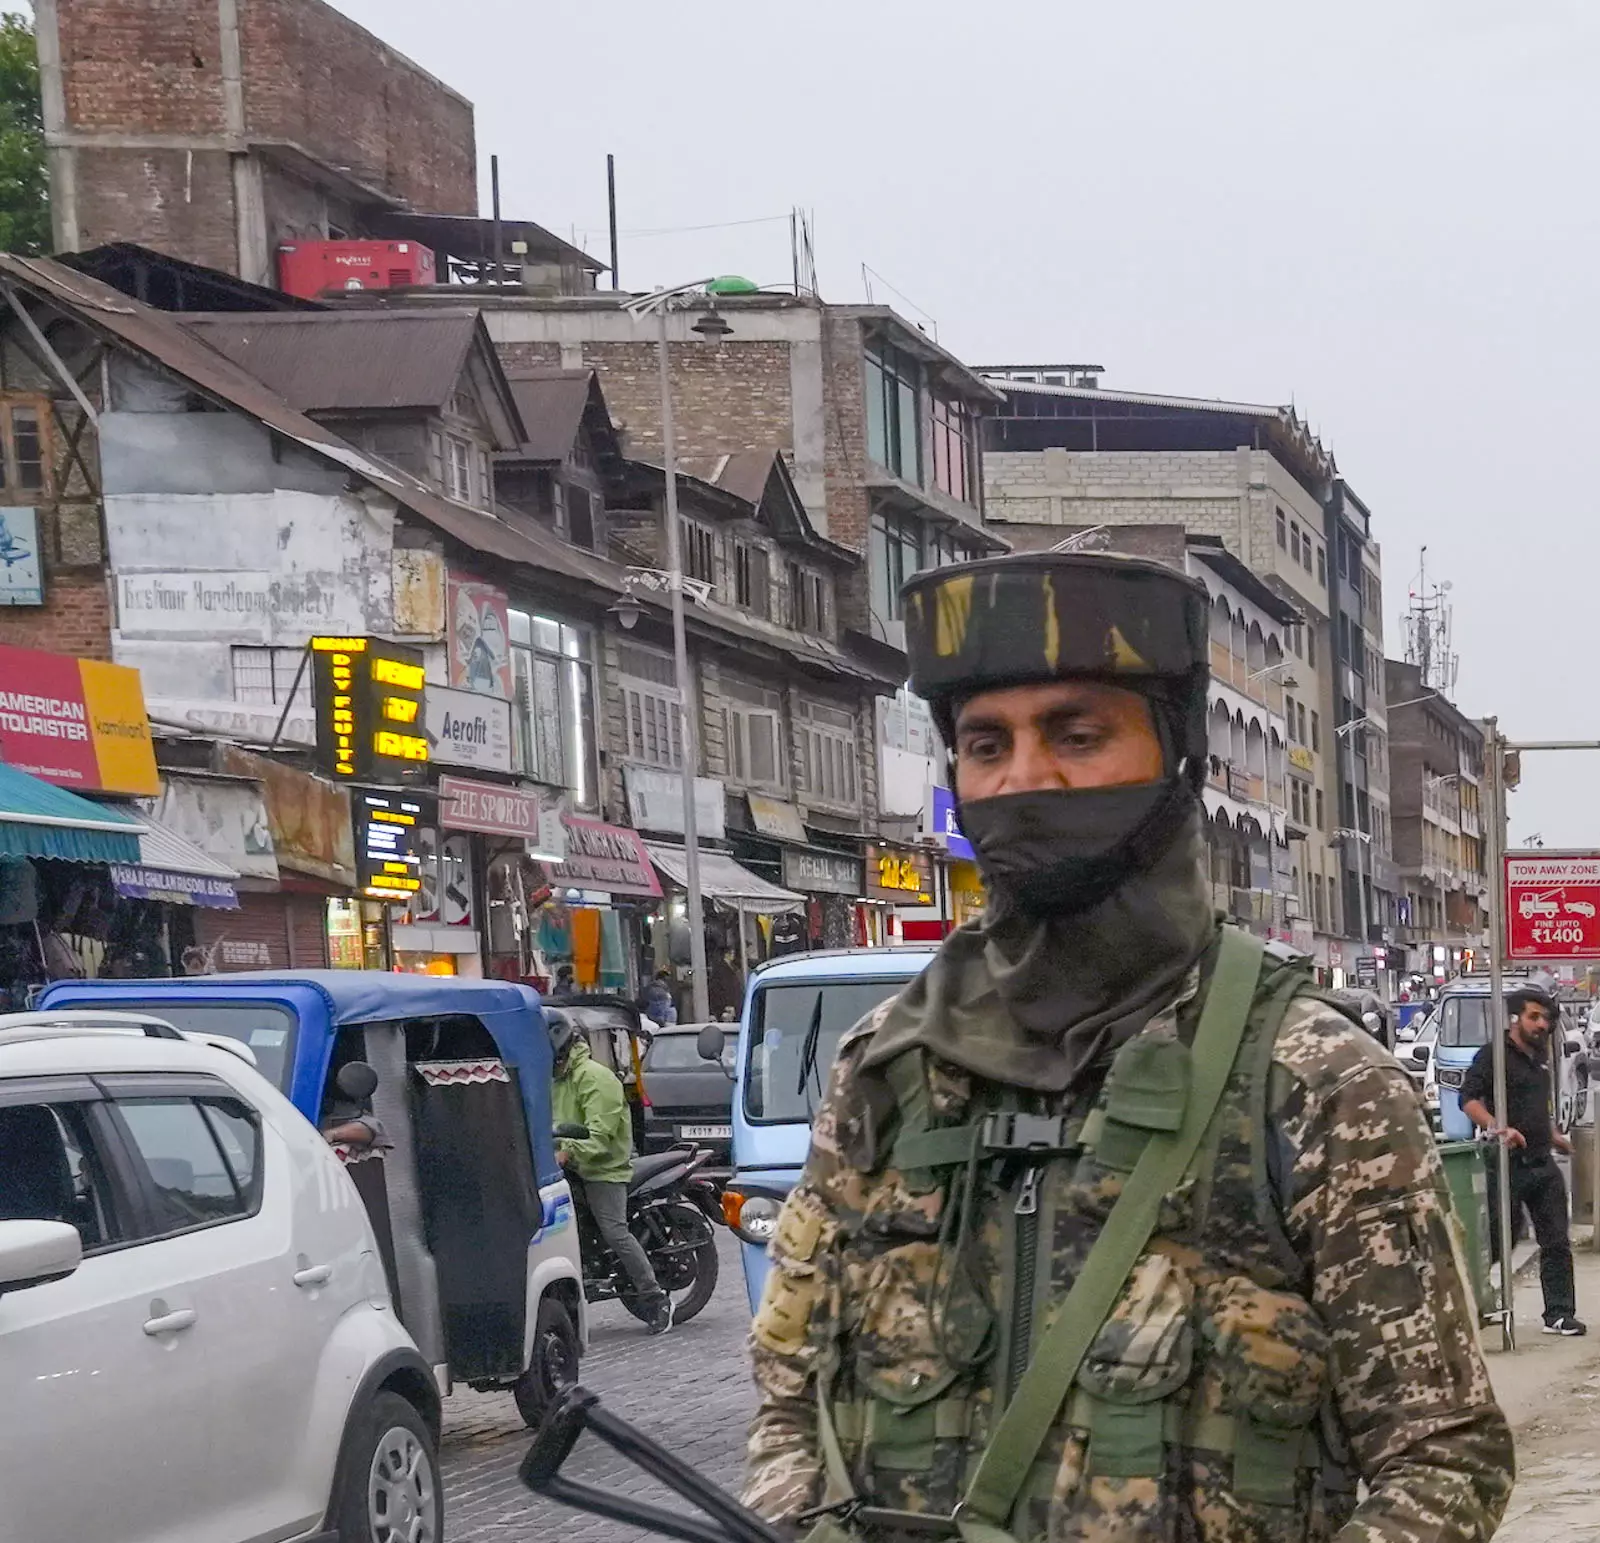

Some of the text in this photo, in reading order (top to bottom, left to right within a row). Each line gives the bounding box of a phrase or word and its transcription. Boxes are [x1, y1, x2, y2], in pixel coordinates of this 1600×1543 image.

[0, 691, 85, 720] AMERICAN
[1, 712, 88, 741] TOURISTER
[442, 711, 487, 745] Aerofit
[450, 788, 530, 828] ZEE SPORTS
[1513, 865, 1599, 875] TOW AWAY ZONE
[1531, 928, 1584, 943] ₹1400
[1534, 919, 1580, 928] FINE UPTO
